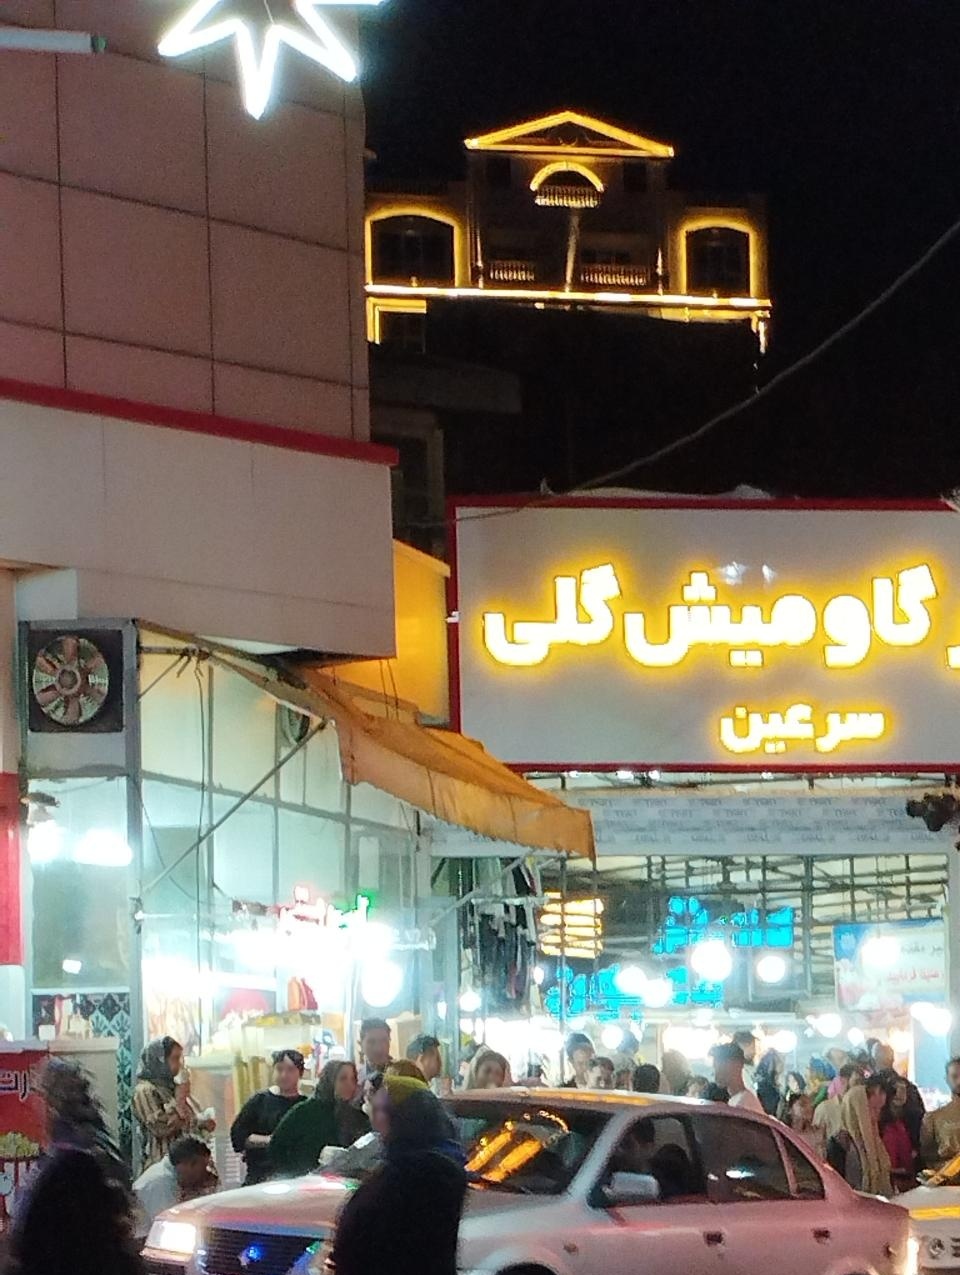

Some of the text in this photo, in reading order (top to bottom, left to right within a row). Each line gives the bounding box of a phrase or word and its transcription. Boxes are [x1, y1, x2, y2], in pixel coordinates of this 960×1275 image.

[482, 562, 623, 667] گلی
[623, 562, 938, 669] گاومیش
[719, 703, 886, 754] سرعین
